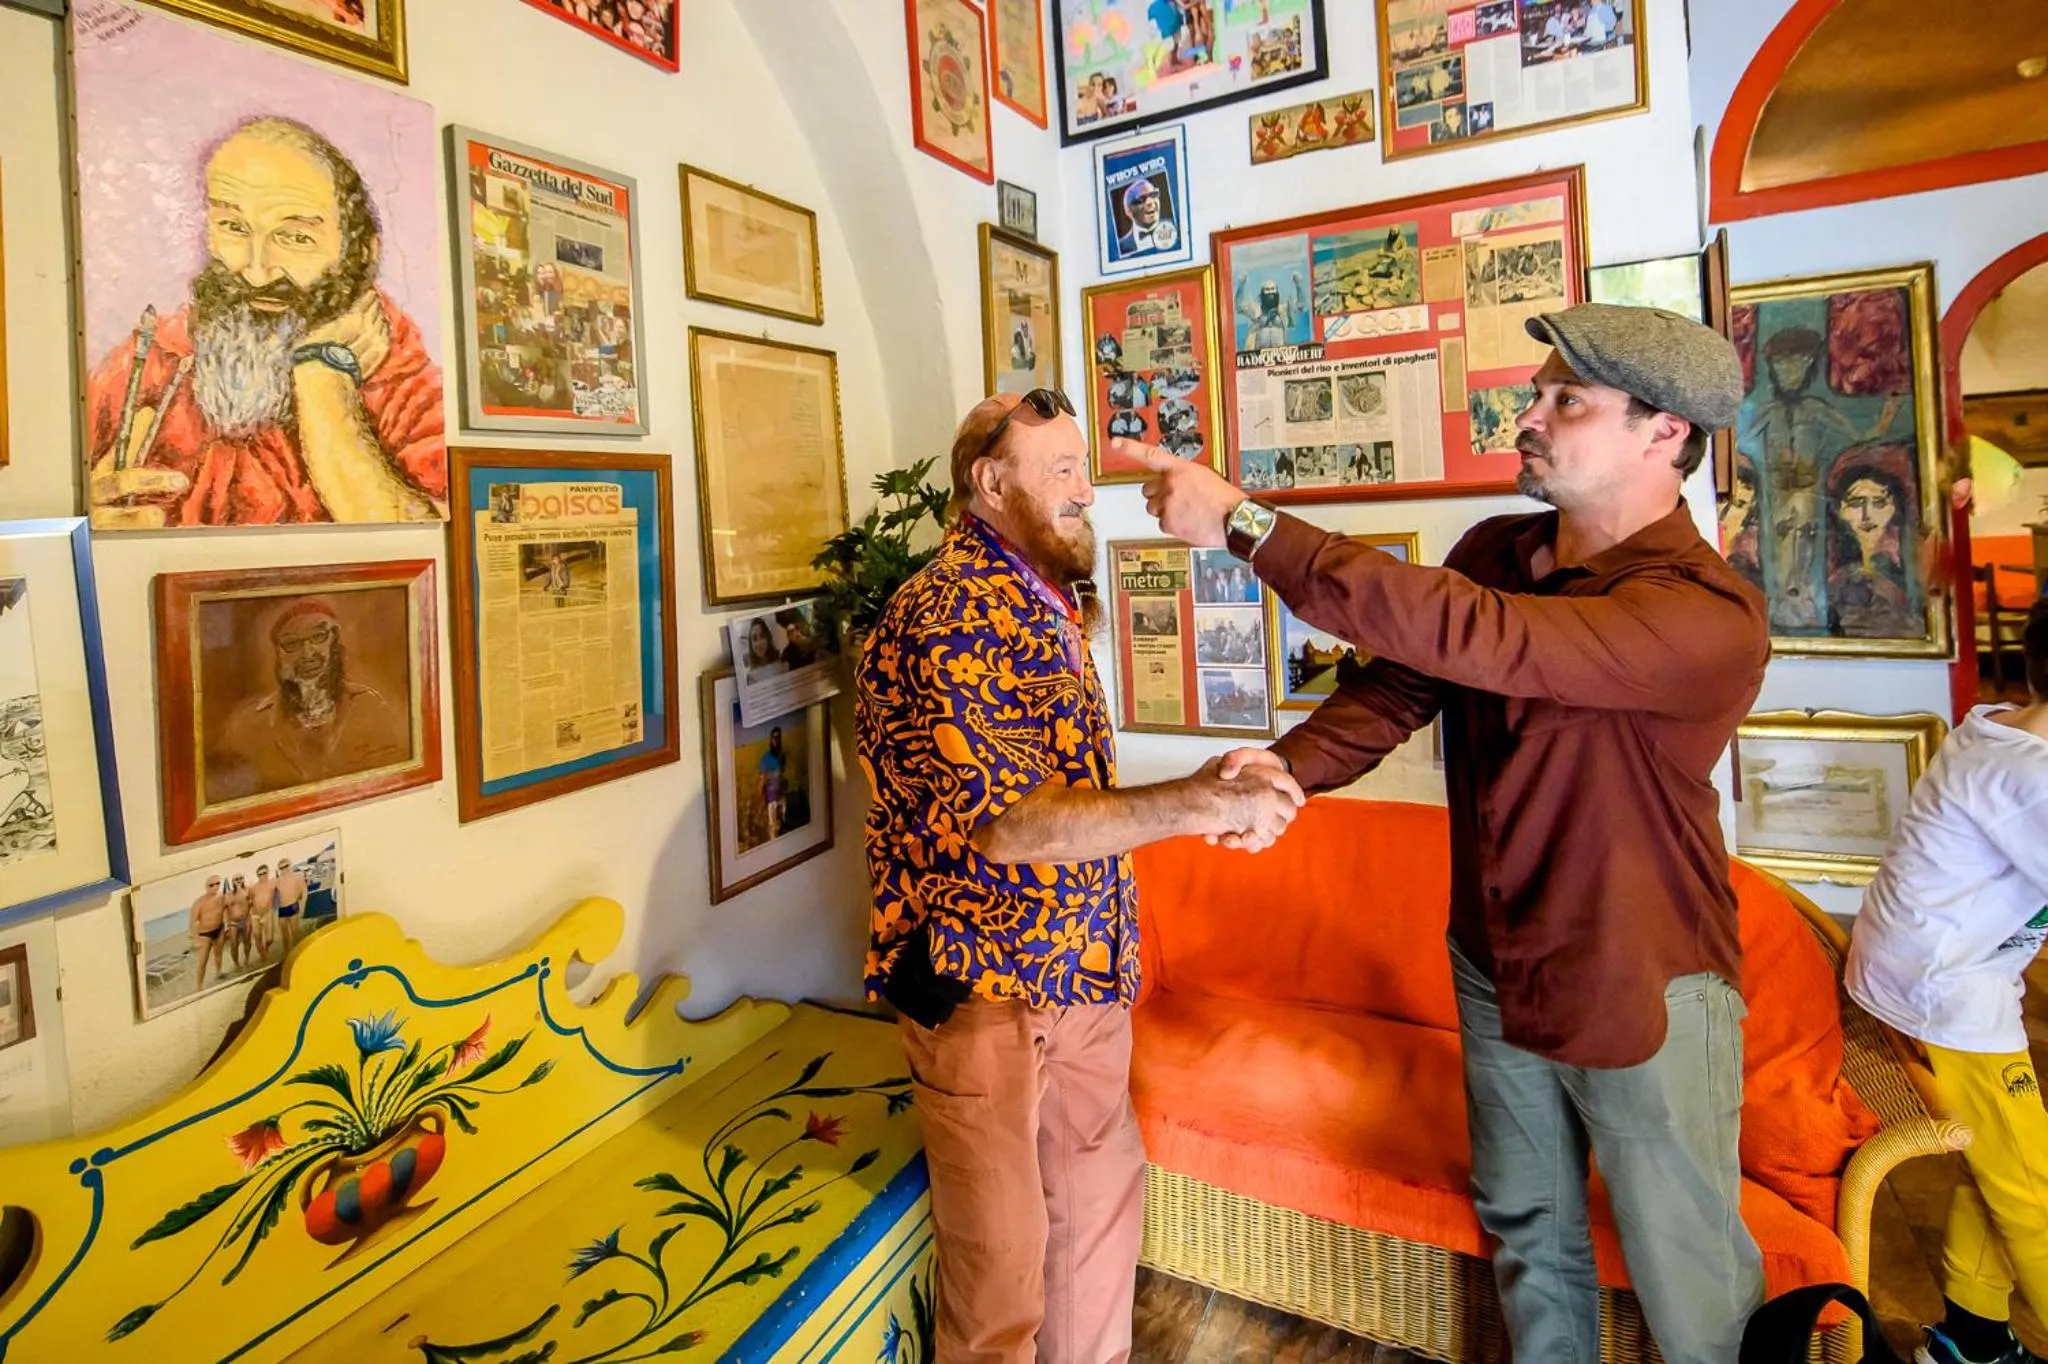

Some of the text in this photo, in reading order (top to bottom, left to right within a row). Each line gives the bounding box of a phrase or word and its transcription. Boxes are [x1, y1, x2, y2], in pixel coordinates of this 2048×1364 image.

[488, 151, 613, 206] Gazzetta del Sud
[1105, 156, 1166, 184] WHO'S WHO
[1267, 365, 1299, 377] Pionieri
[1300, 364, 1315, 374] del
[1316, 362, 1331, 373] riso
[1341, 358, 1380, 371] inventori
[1382, 356, 1392, 367] di
[1393, 351, 1437, 367] spaghetti
[1123, 573, 1171, 589] metro
